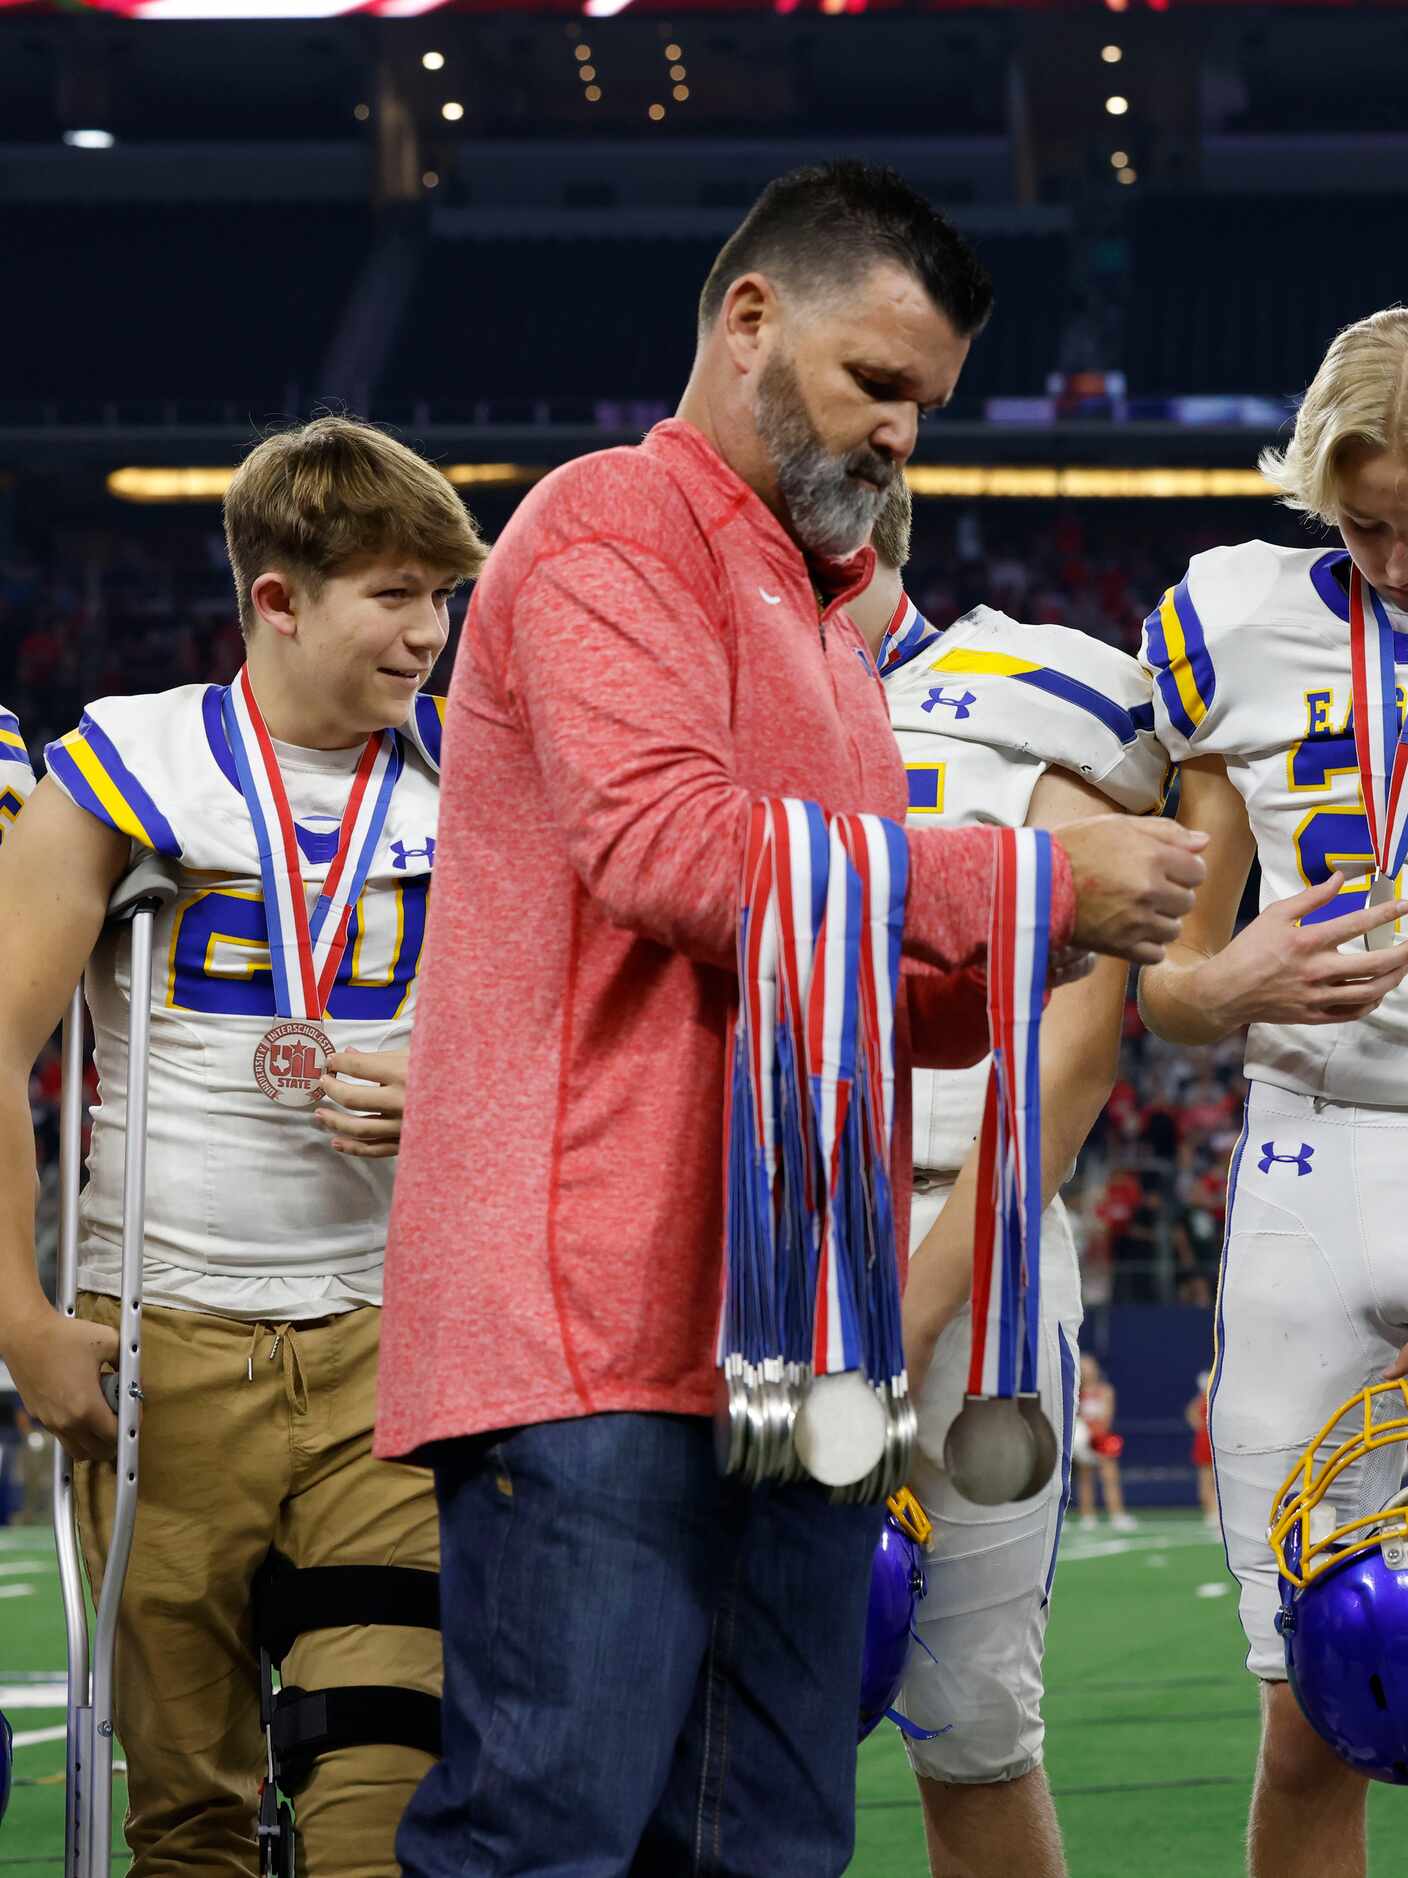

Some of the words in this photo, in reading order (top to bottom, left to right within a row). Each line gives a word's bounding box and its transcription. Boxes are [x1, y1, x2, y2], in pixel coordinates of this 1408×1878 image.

[267, 1024, 334, 1056] INTERSCHOLASTI
[270, 1041, 321, 1079] UIL
[277, 1078, 311, 1089] STATE
